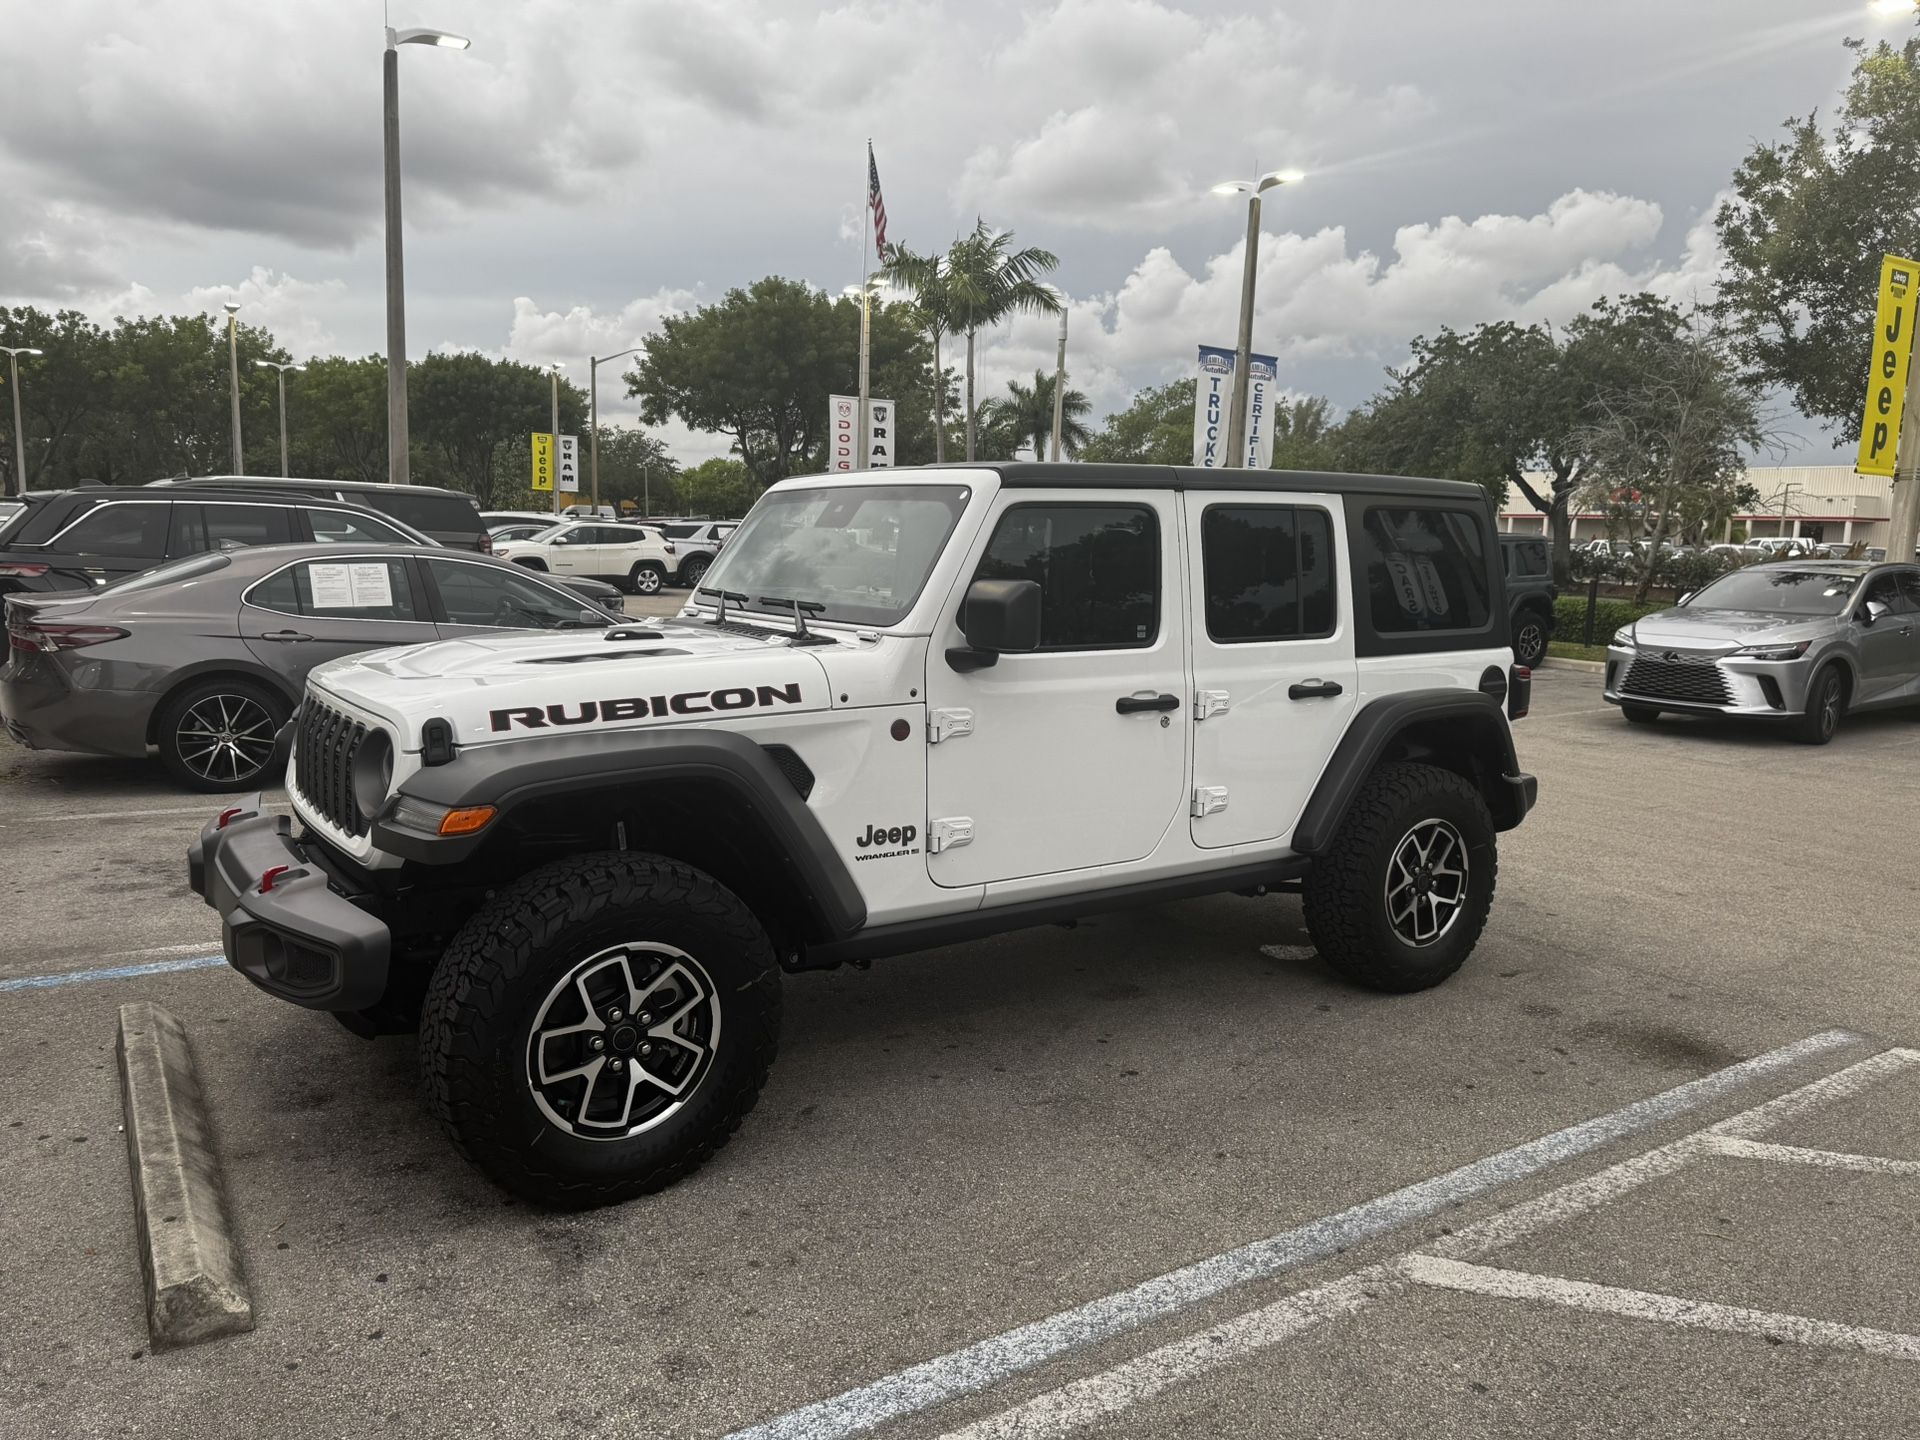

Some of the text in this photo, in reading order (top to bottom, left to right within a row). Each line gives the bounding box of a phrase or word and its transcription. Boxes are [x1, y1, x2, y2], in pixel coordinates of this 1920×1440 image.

[1893, 271, 1907, 284] Jeep
[1870, 306, 1902, 459] Jeep
[1205, 377, 1221, 467] TRUCKS
[1248, 382, 1264, 469] CERTIFIE
[539, 445, 547, 486] Jeep
[562, 452, 574, 482] RAM
[838, 420, 851, 470] DODG
[489, 683, 802, 732] RUBICON
[855, 849, 910, 862] WRANGLER
[856, 824, 917, 848] Jeep
